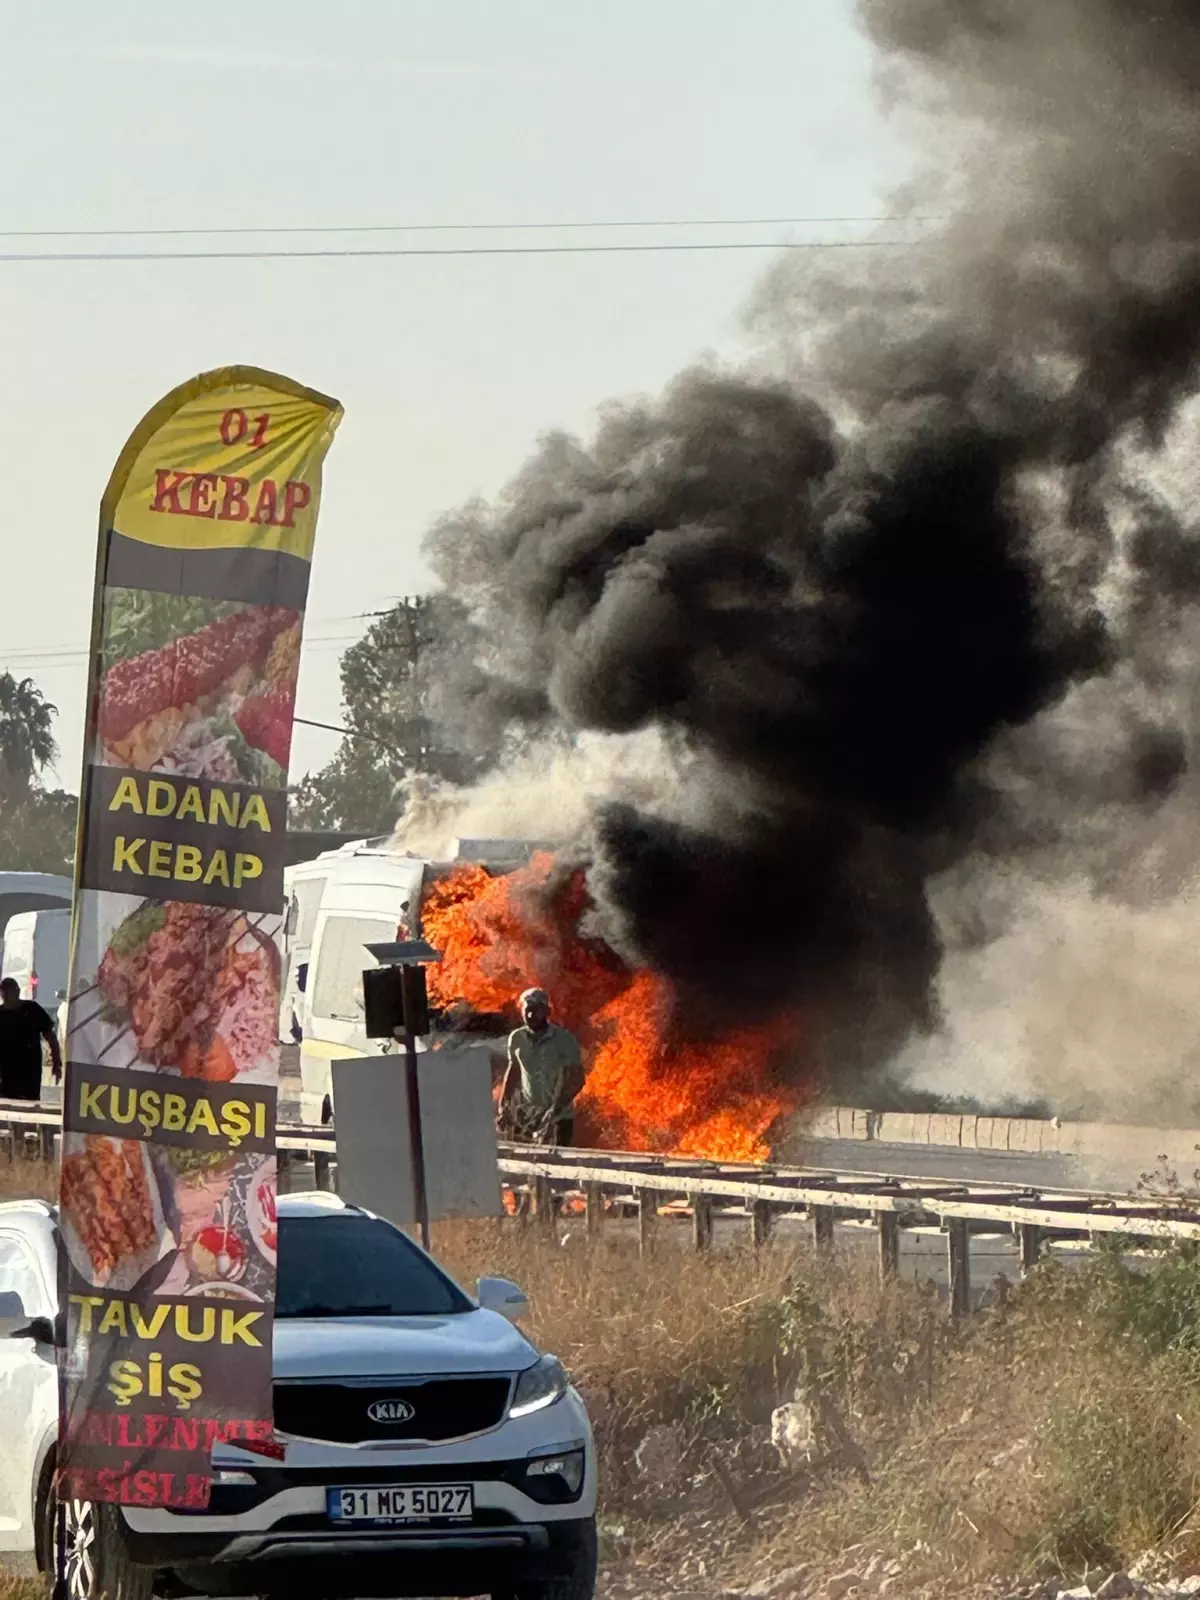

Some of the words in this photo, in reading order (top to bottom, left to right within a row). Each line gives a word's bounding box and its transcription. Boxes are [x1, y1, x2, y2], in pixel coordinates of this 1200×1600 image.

[149, 469, 312, 528] KEBAP
[108, 776, 272, 833] ADANA
[112, 835, 264, 889] KEBAP
[79, 1081, 266, 1146] KUŞBAŞI
[69, 1294, 265, 1347] TAVUK
[108, 1352, 202, 1410] ŞİŞ
[376, 1403, 409, 1419] KIA
[342, 1492, 369, 1516] 31
[377, 1491, 405, 1515] MC
[412, 1489, 470, 1514] 5027
